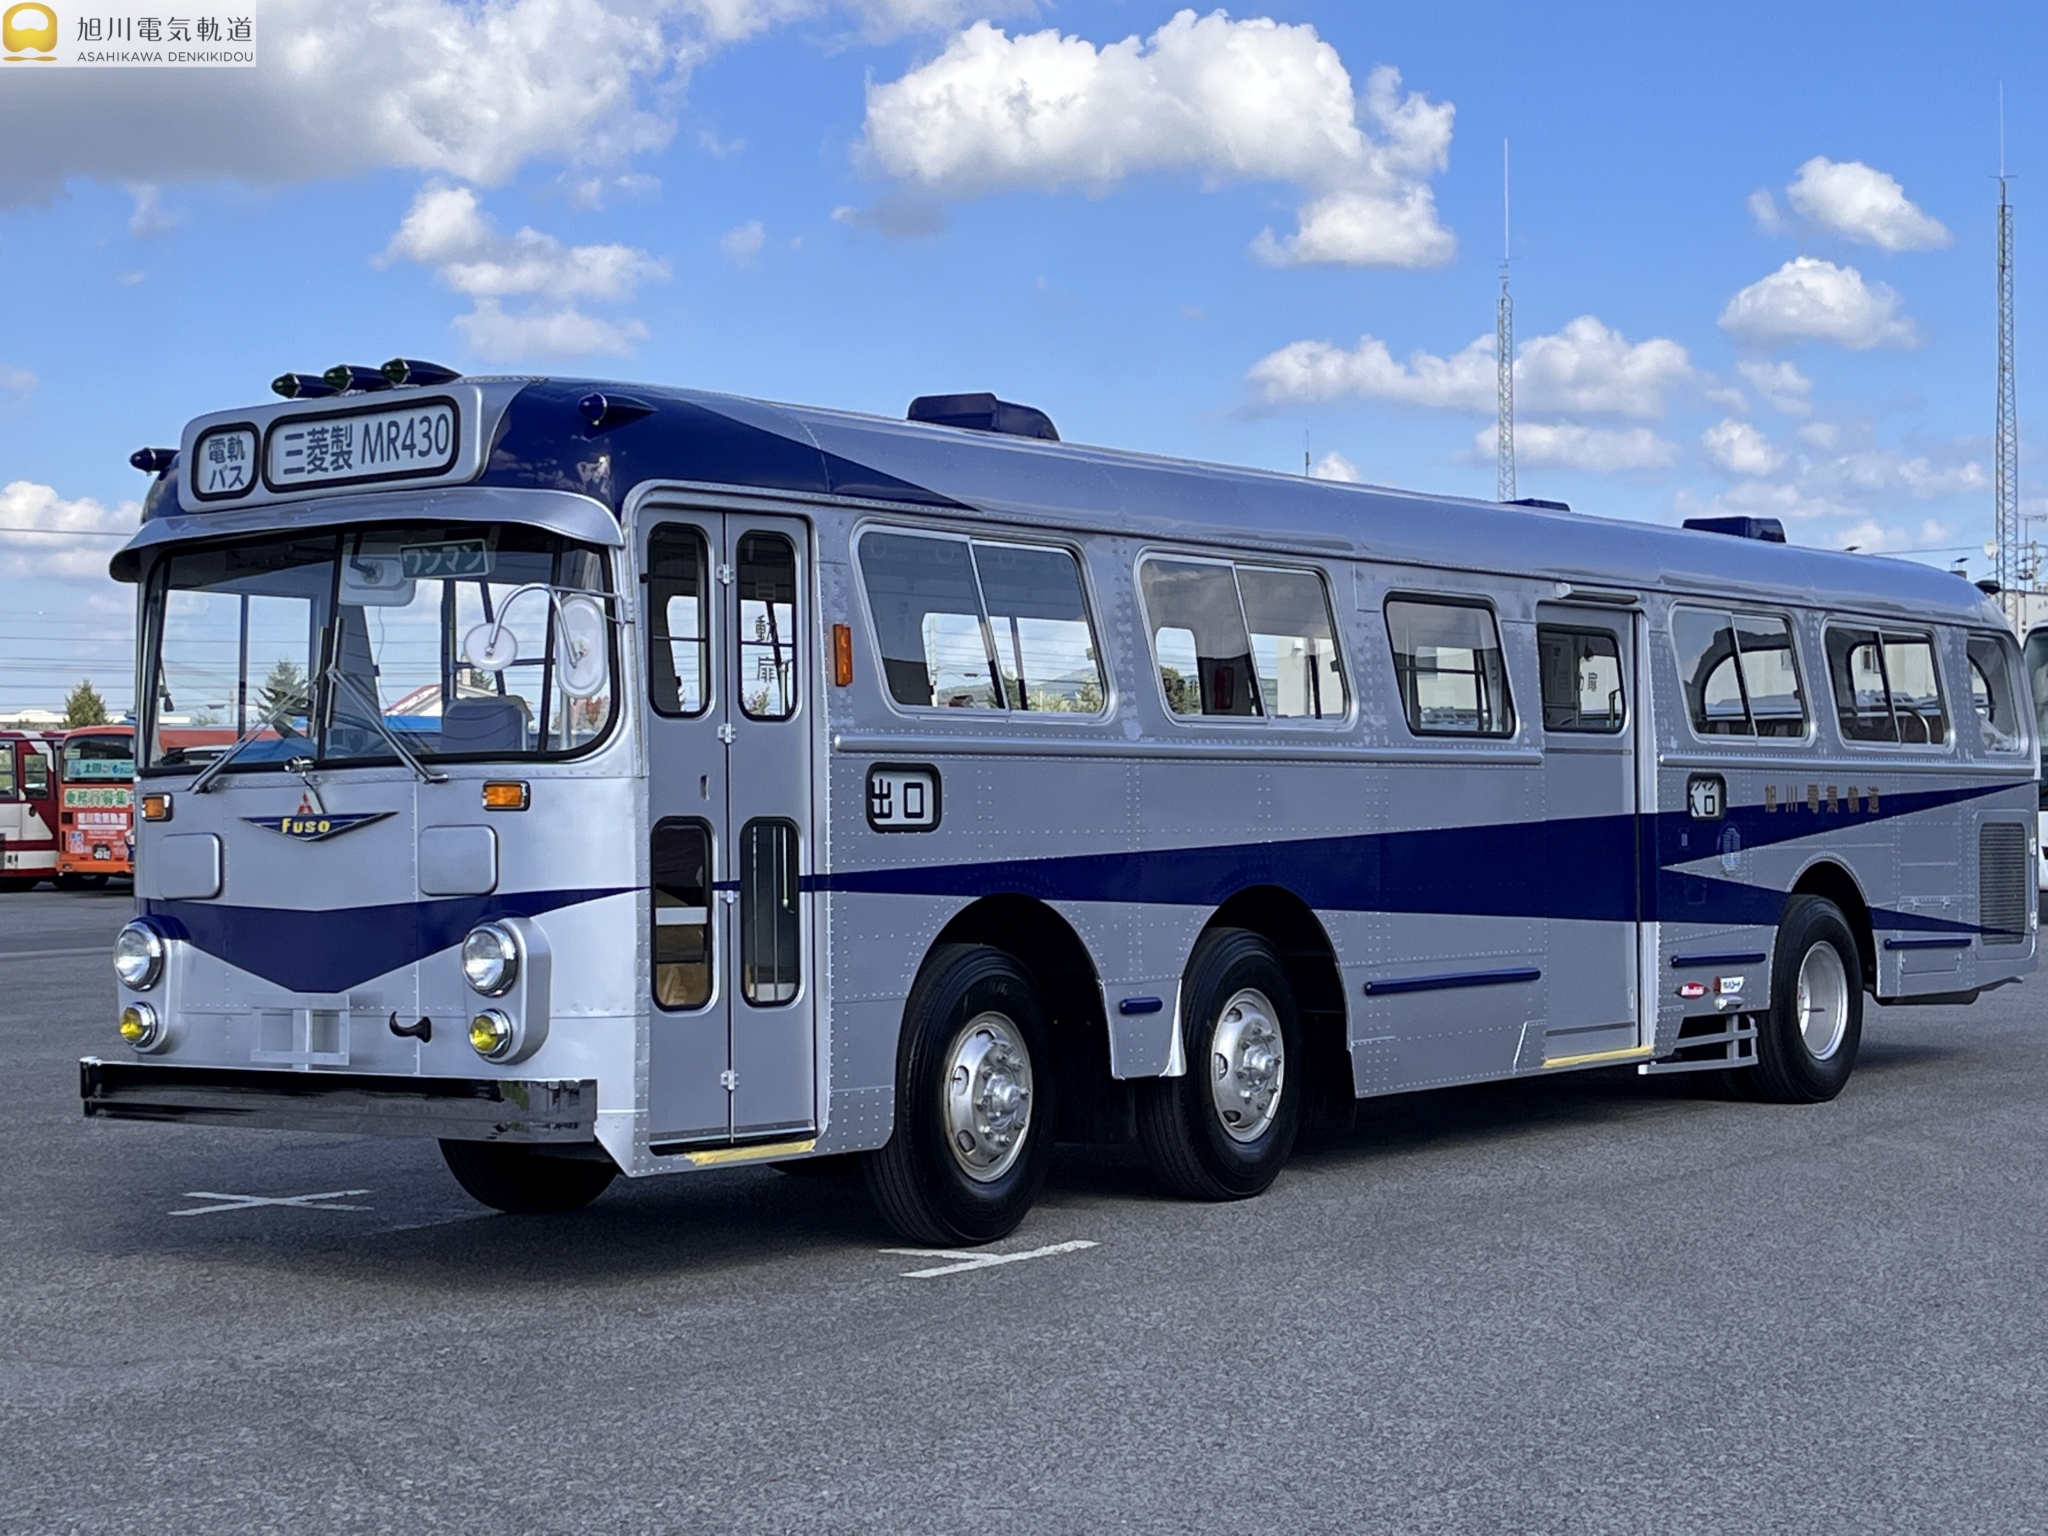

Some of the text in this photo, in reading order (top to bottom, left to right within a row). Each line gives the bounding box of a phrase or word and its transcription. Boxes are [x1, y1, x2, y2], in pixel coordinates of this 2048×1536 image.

[208, 435, 246, 464] 電軌
[208, 465, 245, 491] バス
[403, 544, 483, 574] ワンマン
[871, 778, 924, 819] 出口
